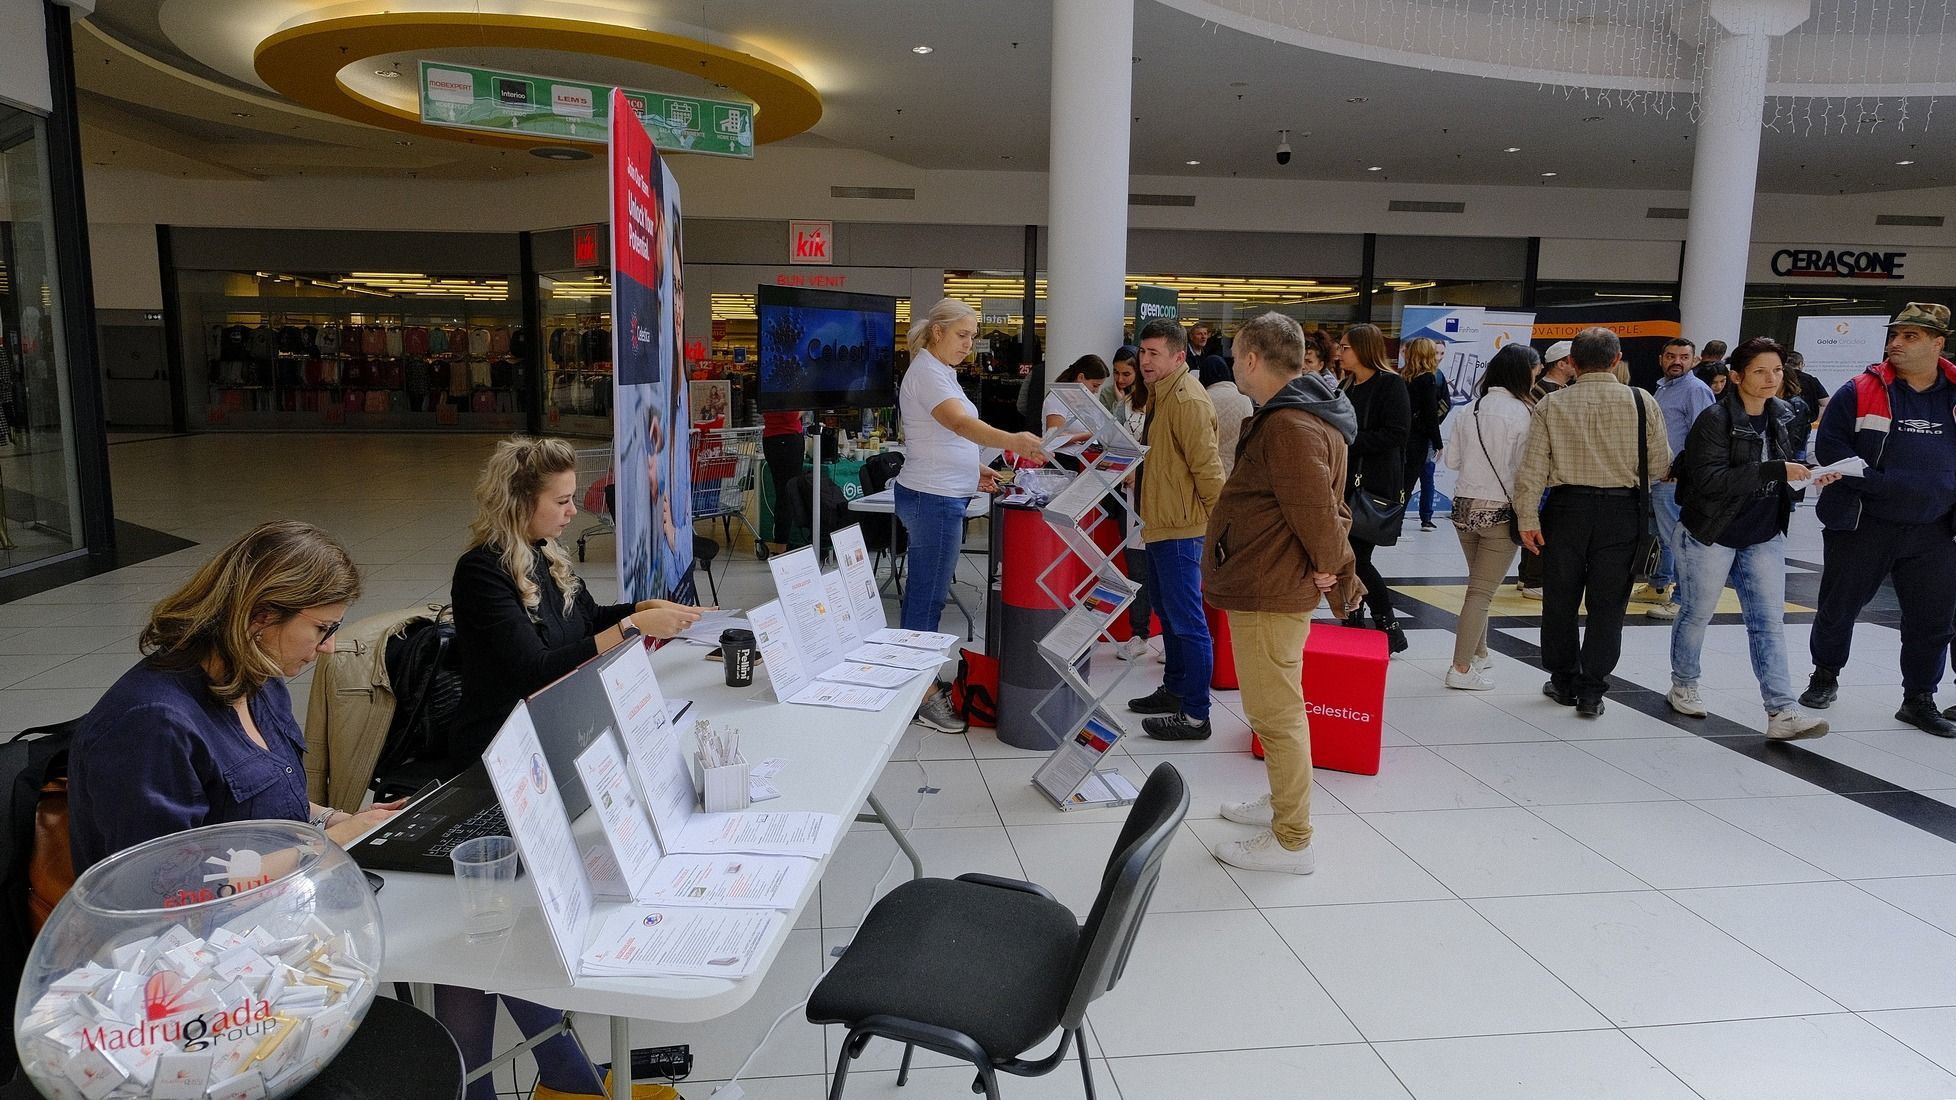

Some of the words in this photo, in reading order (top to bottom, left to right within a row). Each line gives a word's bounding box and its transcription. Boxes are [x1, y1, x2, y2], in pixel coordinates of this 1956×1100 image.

[429, 80, 472, 92] MOBEXPERT
[628, 189, 644, 229] Unlock
[796, 228, 827, 258] kik
[1770, 249, 1907, 280] CERASONE
[808, 275, 848, 288] VENIT
[1531, 326, 1583, 336] OVATION
[740, 648, 750, 680] Pellini
[1303, 701, 1371, 723] Celestica
[80, 997, 272, 1053] Madrugada
